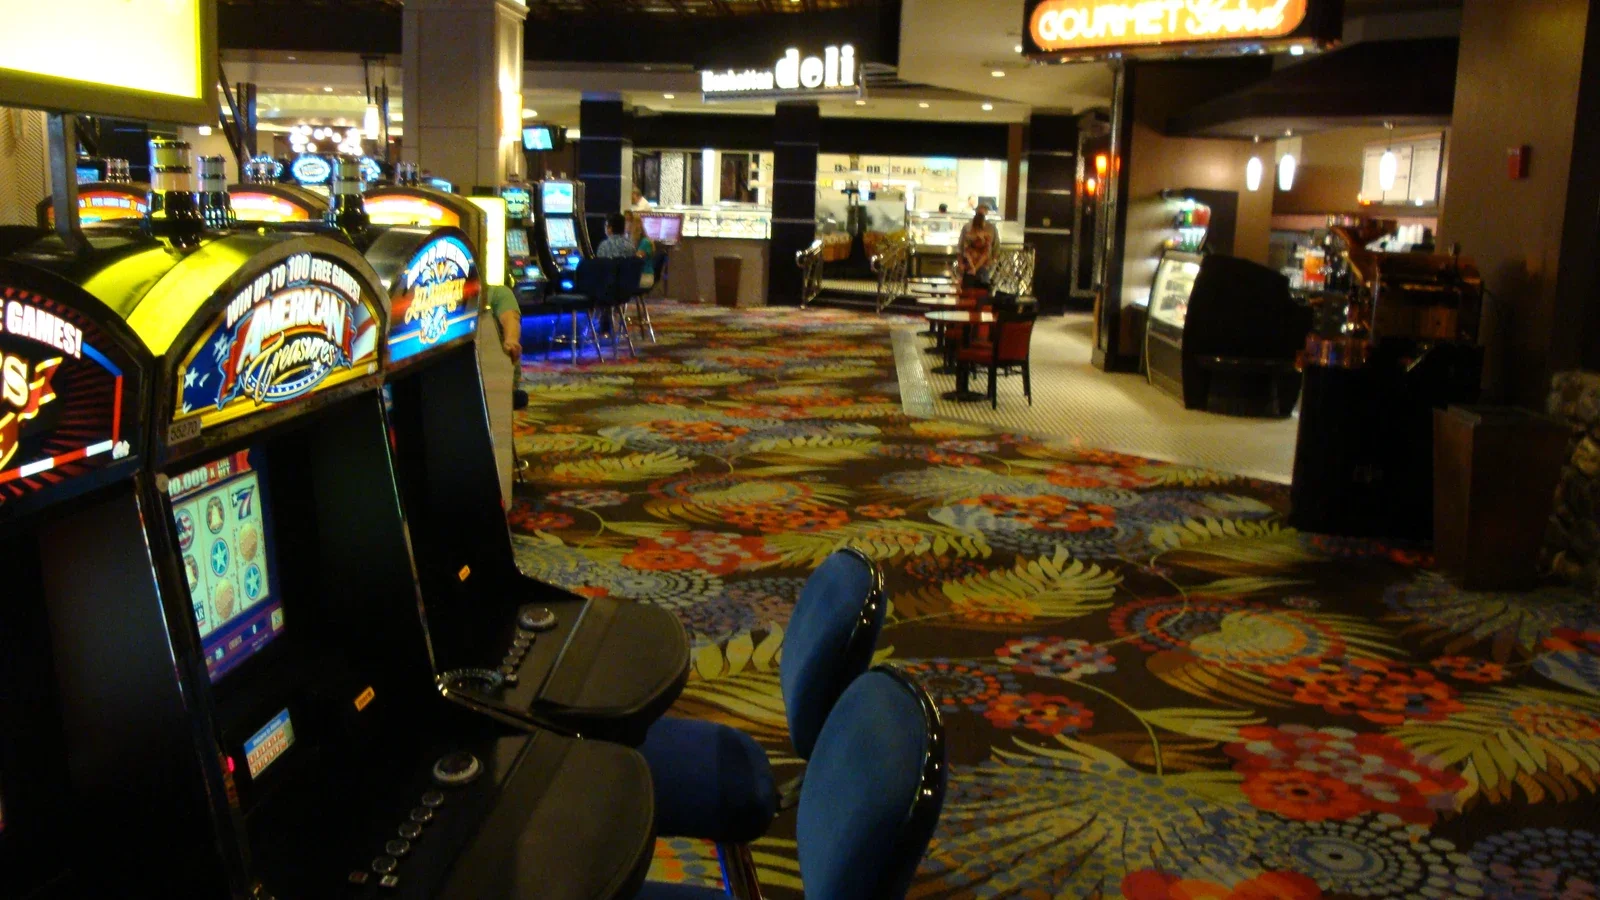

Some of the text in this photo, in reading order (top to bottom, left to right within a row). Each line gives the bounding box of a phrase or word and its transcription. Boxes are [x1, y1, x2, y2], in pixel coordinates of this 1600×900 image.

[1038, 1, 1184, 41] GOURMET
[775, 45, 855, 88] deli
[227, 252, 361, 328] WIN UP TO 100 FREE GAMES!
[7, 300, 83, 360] GAMES!
[236, 287, 346, 373] AMERICAN
[243, 330, 335, 406] Treasures
